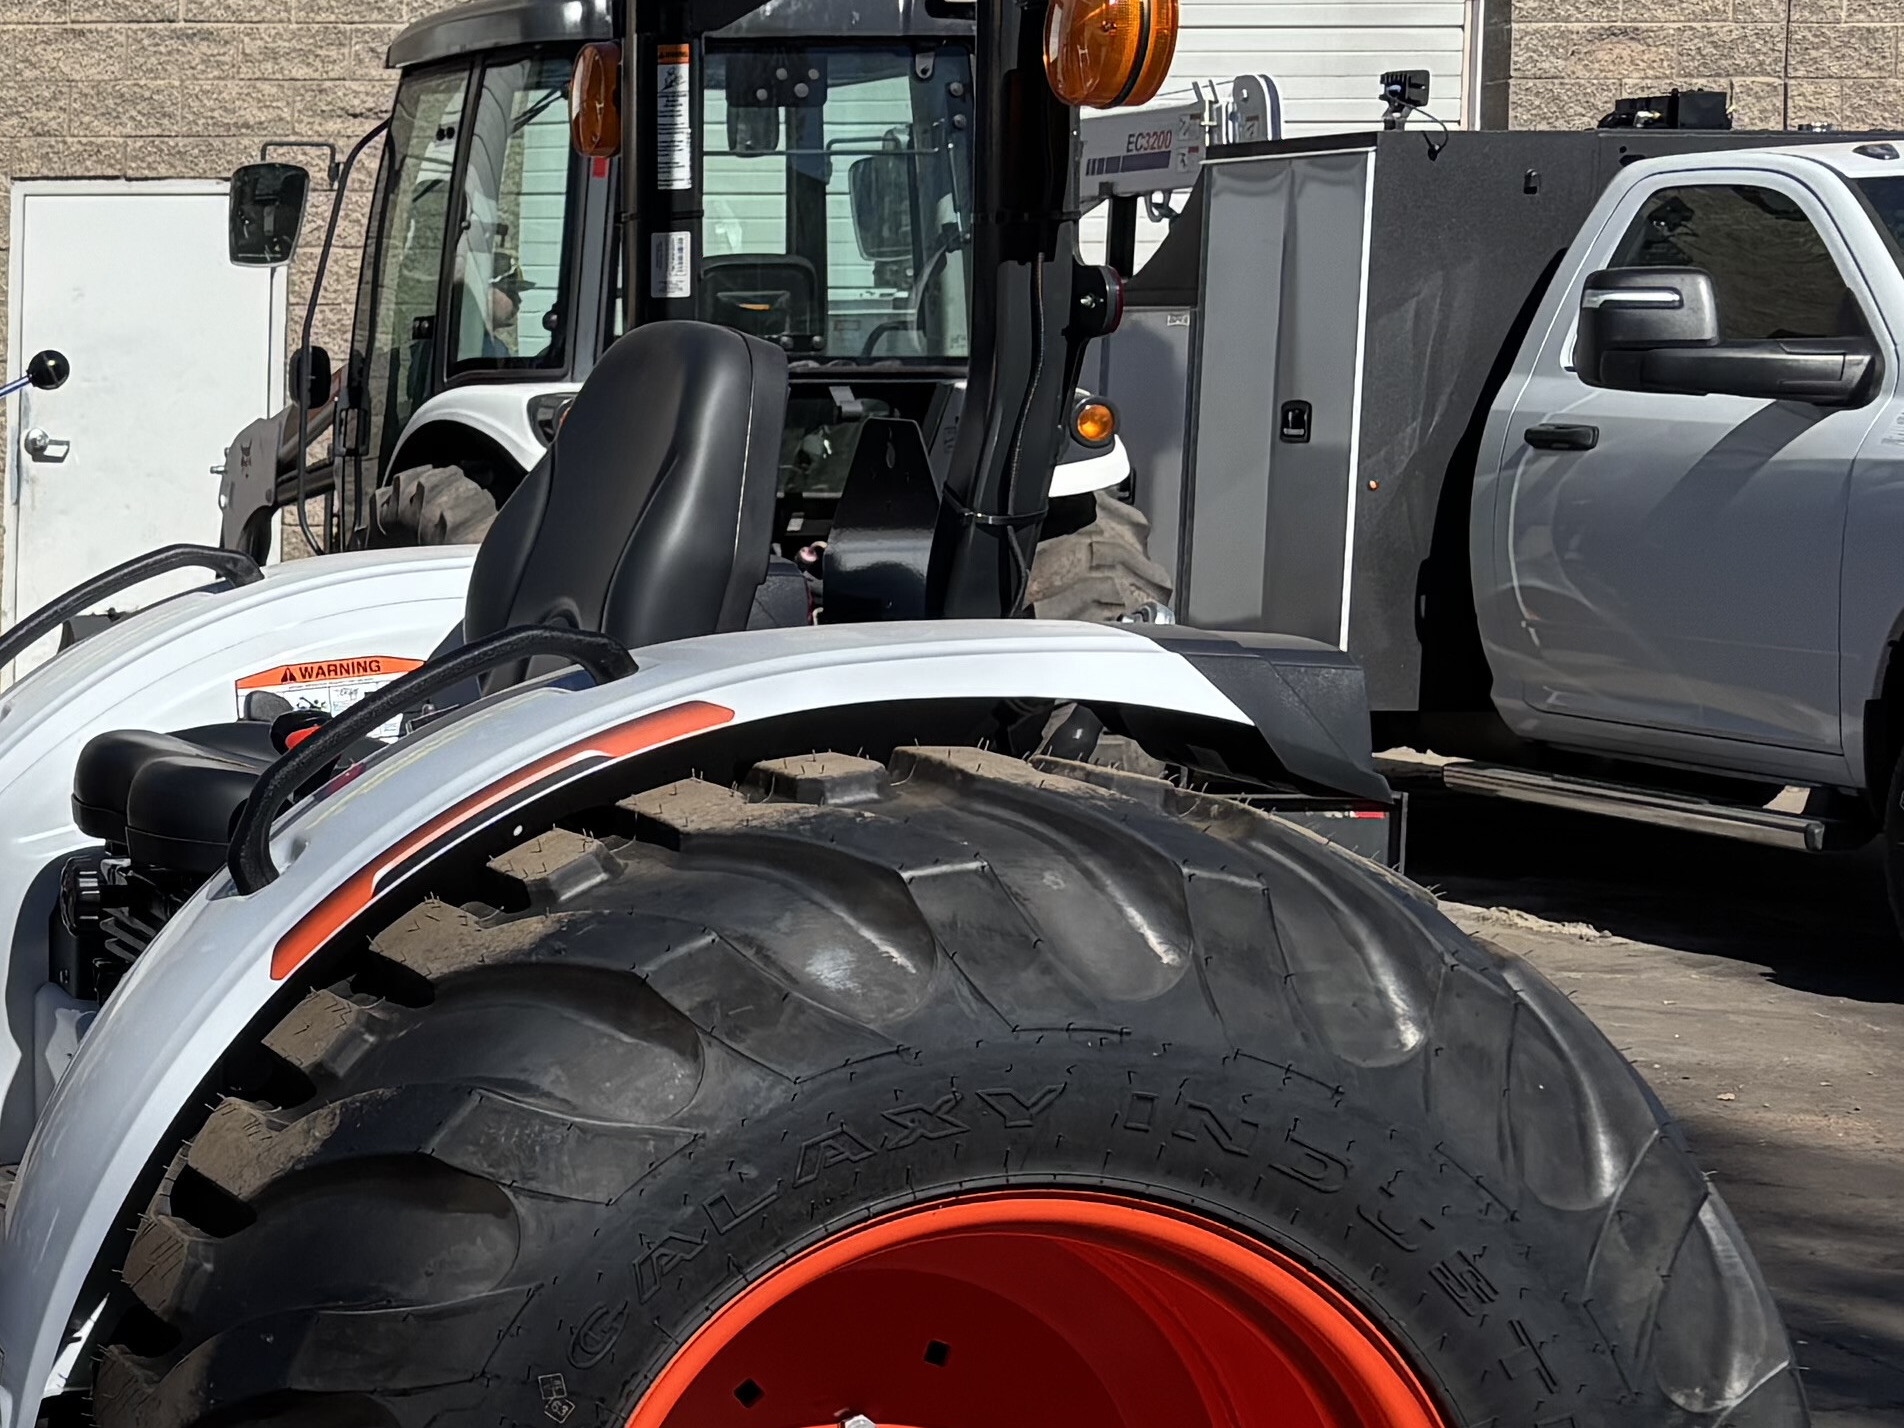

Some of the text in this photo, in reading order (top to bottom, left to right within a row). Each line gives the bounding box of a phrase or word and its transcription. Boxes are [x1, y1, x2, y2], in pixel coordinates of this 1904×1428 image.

[1125, 129, 1173, 154] EC3200
[298, 659, 381, 680] WARNING
[567, 1081, 1067, 1370] GALAXY
